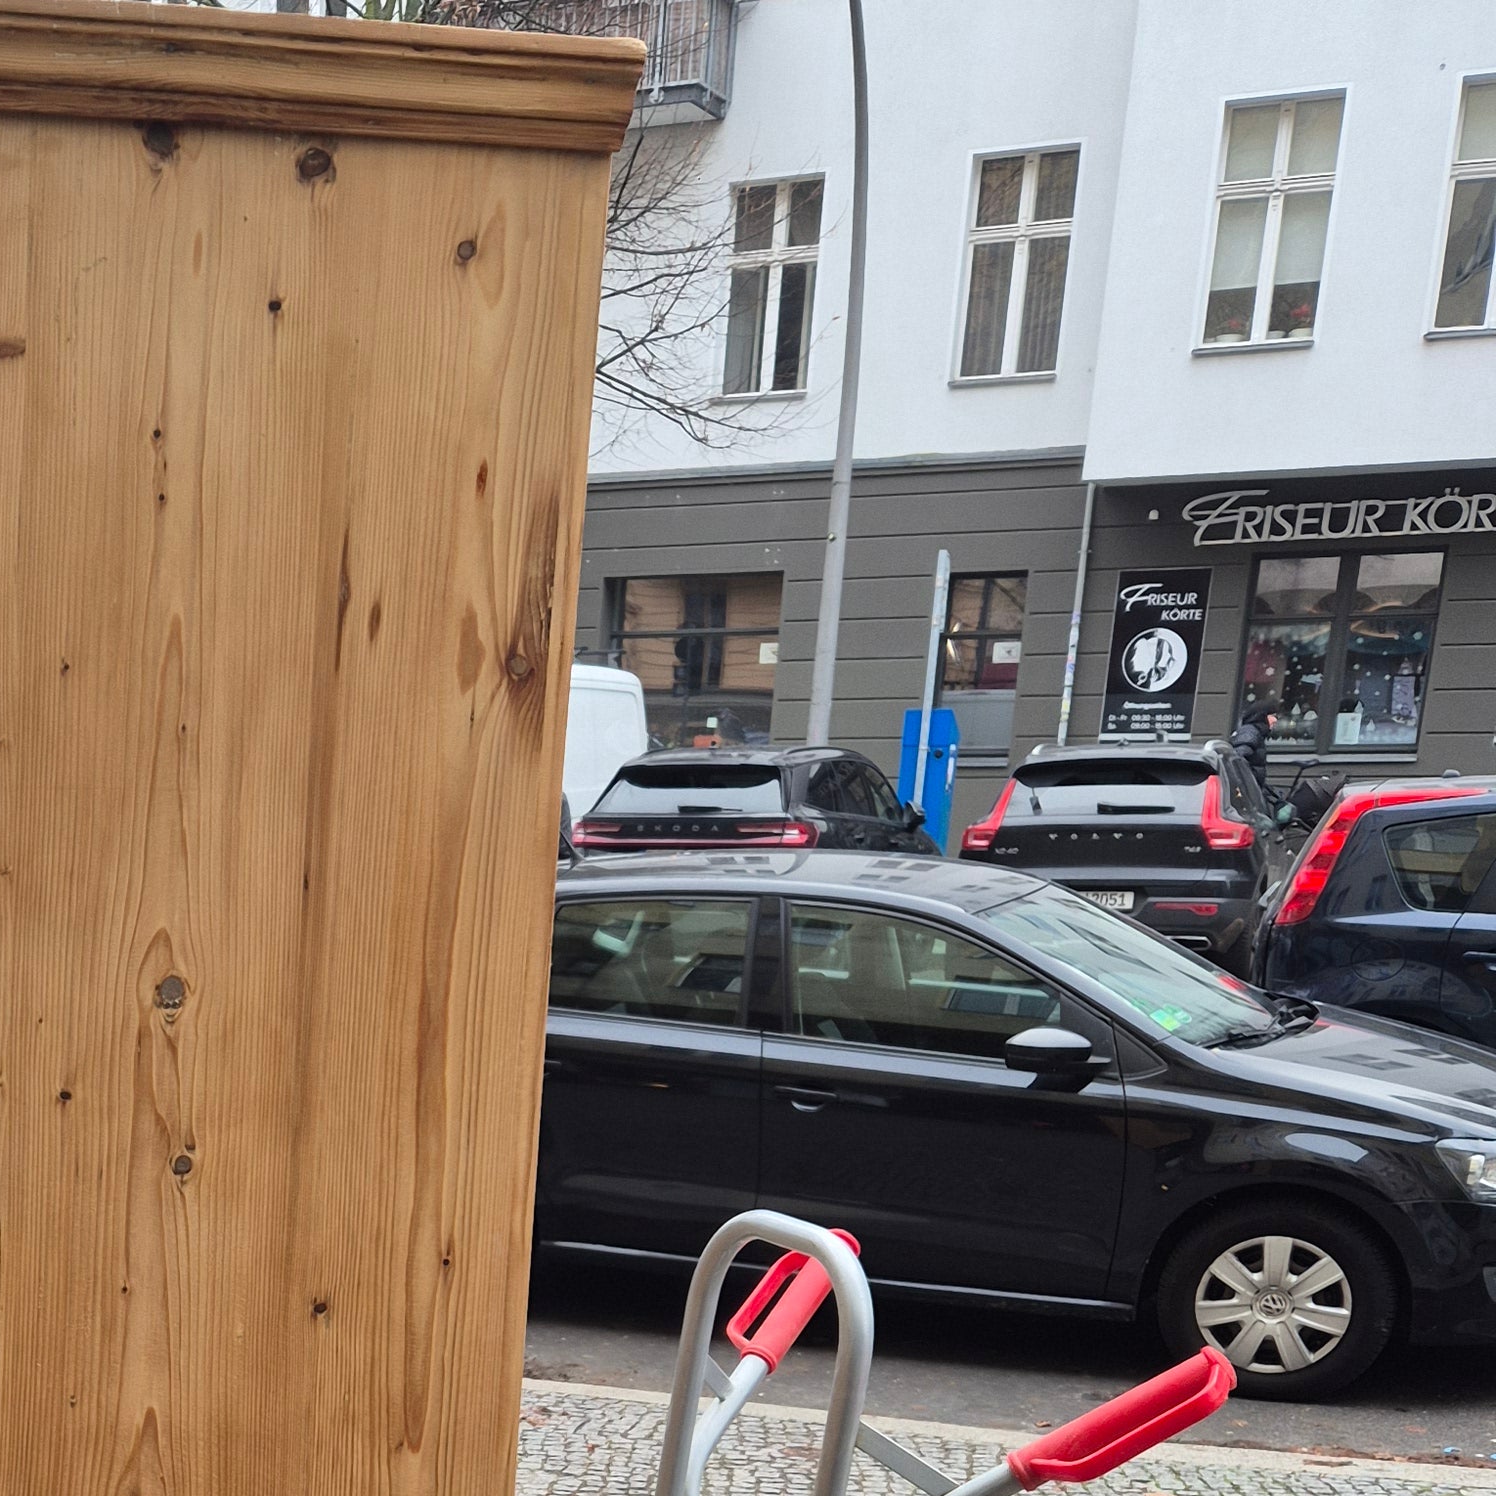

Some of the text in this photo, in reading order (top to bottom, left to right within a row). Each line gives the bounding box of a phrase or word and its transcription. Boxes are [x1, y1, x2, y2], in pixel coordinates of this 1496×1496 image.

[1182, 487, 1496, 547] FRISEUR KÖR
[1120, 583, 1198, 612] FRISEUR
[1161, 608, 1203, 621] KÖRTE
[1092, 892, 1126, 907] 2051
